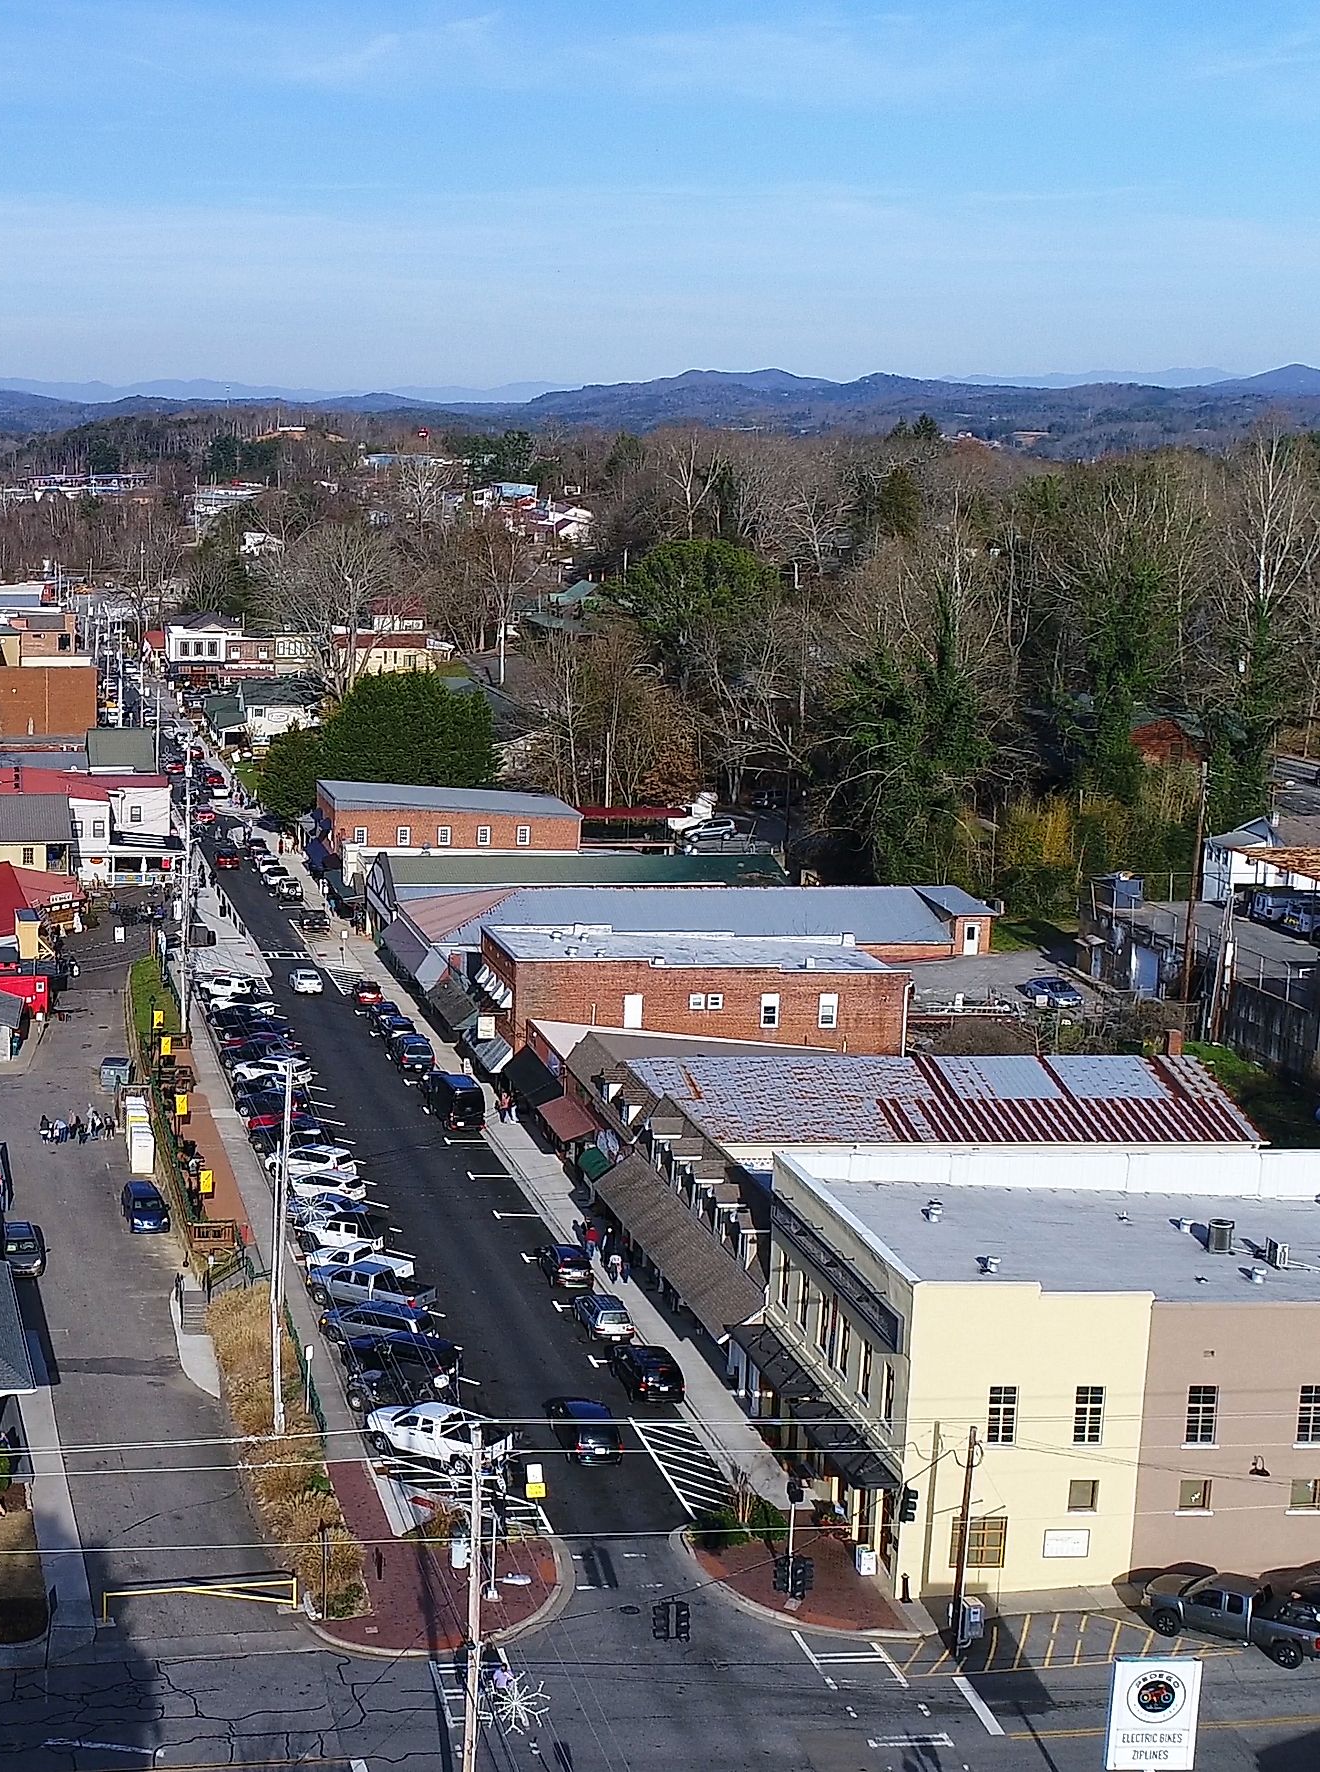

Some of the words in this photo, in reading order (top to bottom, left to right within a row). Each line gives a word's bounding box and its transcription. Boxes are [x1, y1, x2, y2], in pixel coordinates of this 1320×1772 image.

[1135, 1673, 1181, 1689] PEDEGO
[1122, 1733, 1158, 1744] ELECTRIC
[1159, 1733, 1183, 1744] BIKES
[1132, 1749, 1169, 1761] ZIPLINES
